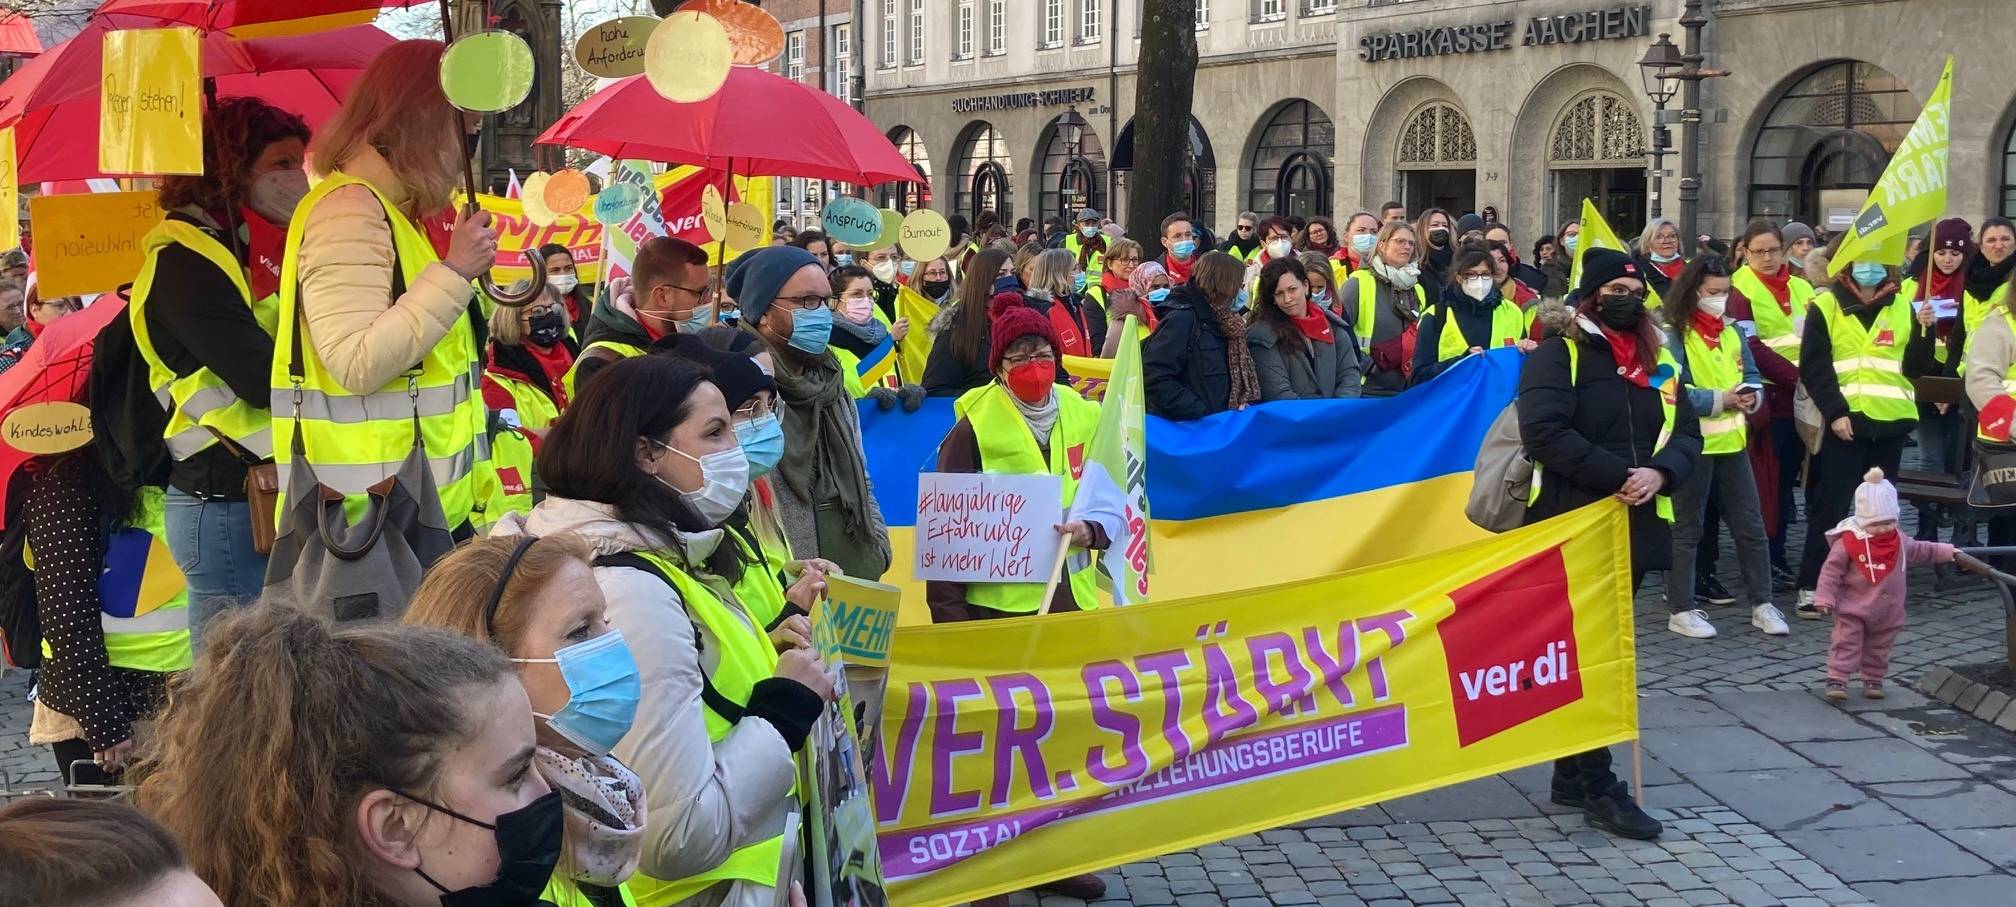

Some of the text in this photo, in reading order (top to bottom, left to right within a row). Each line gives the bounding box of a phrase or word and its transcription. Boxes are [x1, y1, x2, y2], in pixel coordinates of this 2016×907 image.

[600, 28, 628, 42] hohe
[1359, 6, 1649, 62] SPARKASSE AACHEN
[952, 87, 1095, 112] BUCHHANDLUNG SCHMETZ
[826, 210, 877, 234] Anspruch
[903, 225, 942, 239] Burnout
[919, 482, 1026, 522] #langjährige
[928, 517, 1031, 556] Erfahrung
[921, 547, 1033, 578] ist mehr Wert
[1459, 640, 1568, 701] ver.di
[1102, 720, 1363, 800] ZIEHUNGSBERUFE
